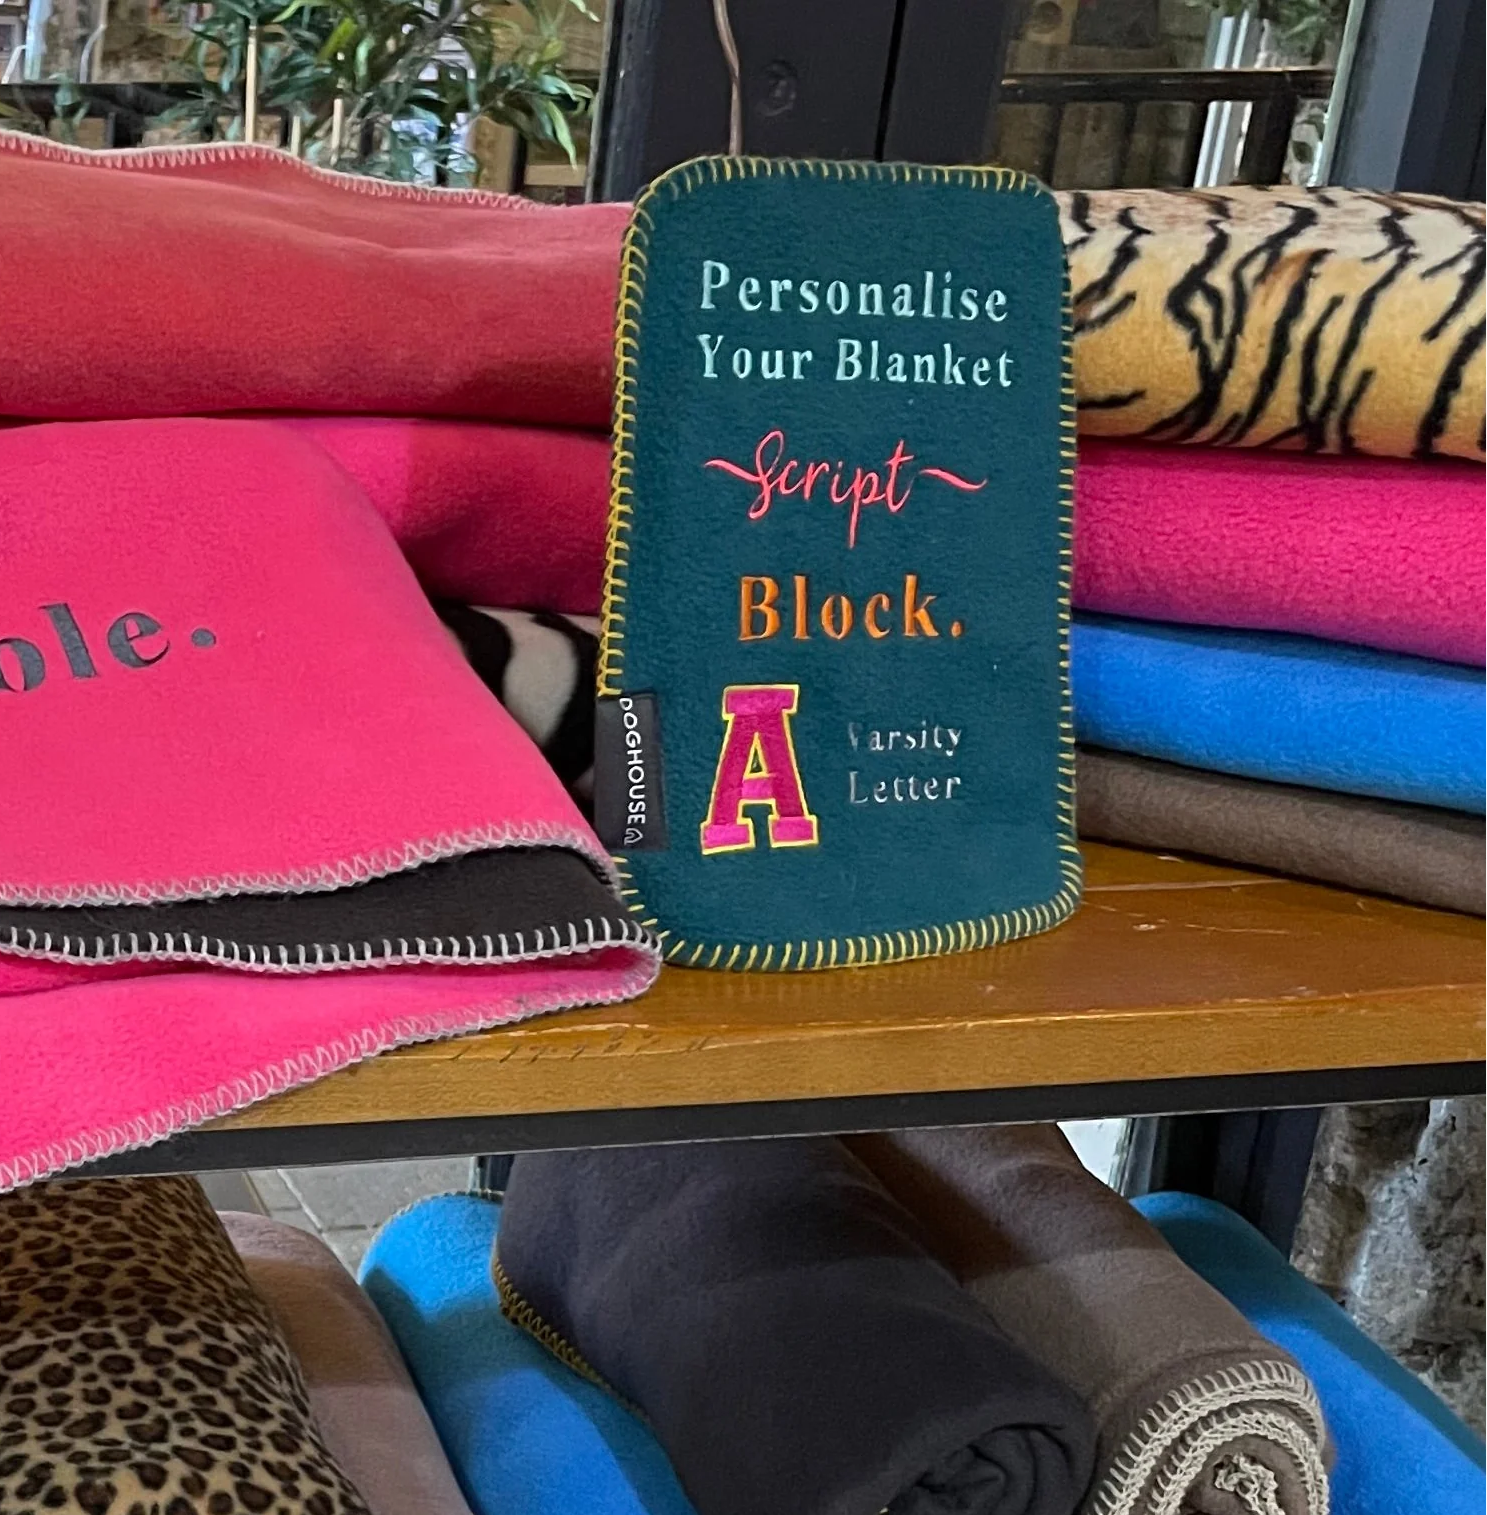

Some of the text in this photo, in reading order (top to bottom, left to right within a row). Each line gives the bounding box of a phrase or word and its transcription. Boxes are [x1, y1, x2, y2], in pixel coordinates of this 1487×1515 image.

[700, 260, 1009, 322] Personalise
[696, 334, 1014, 388] Your Blanket
[704, 430, 988, 549] Script
[738, 574, 964, 642] Block.
[619, 698, 647, 825] DOGHOUSE
[701, 684, 819, 856] A
[848, 720, 962, 757] Varsity
[849, 770, 962, 806] Letter
